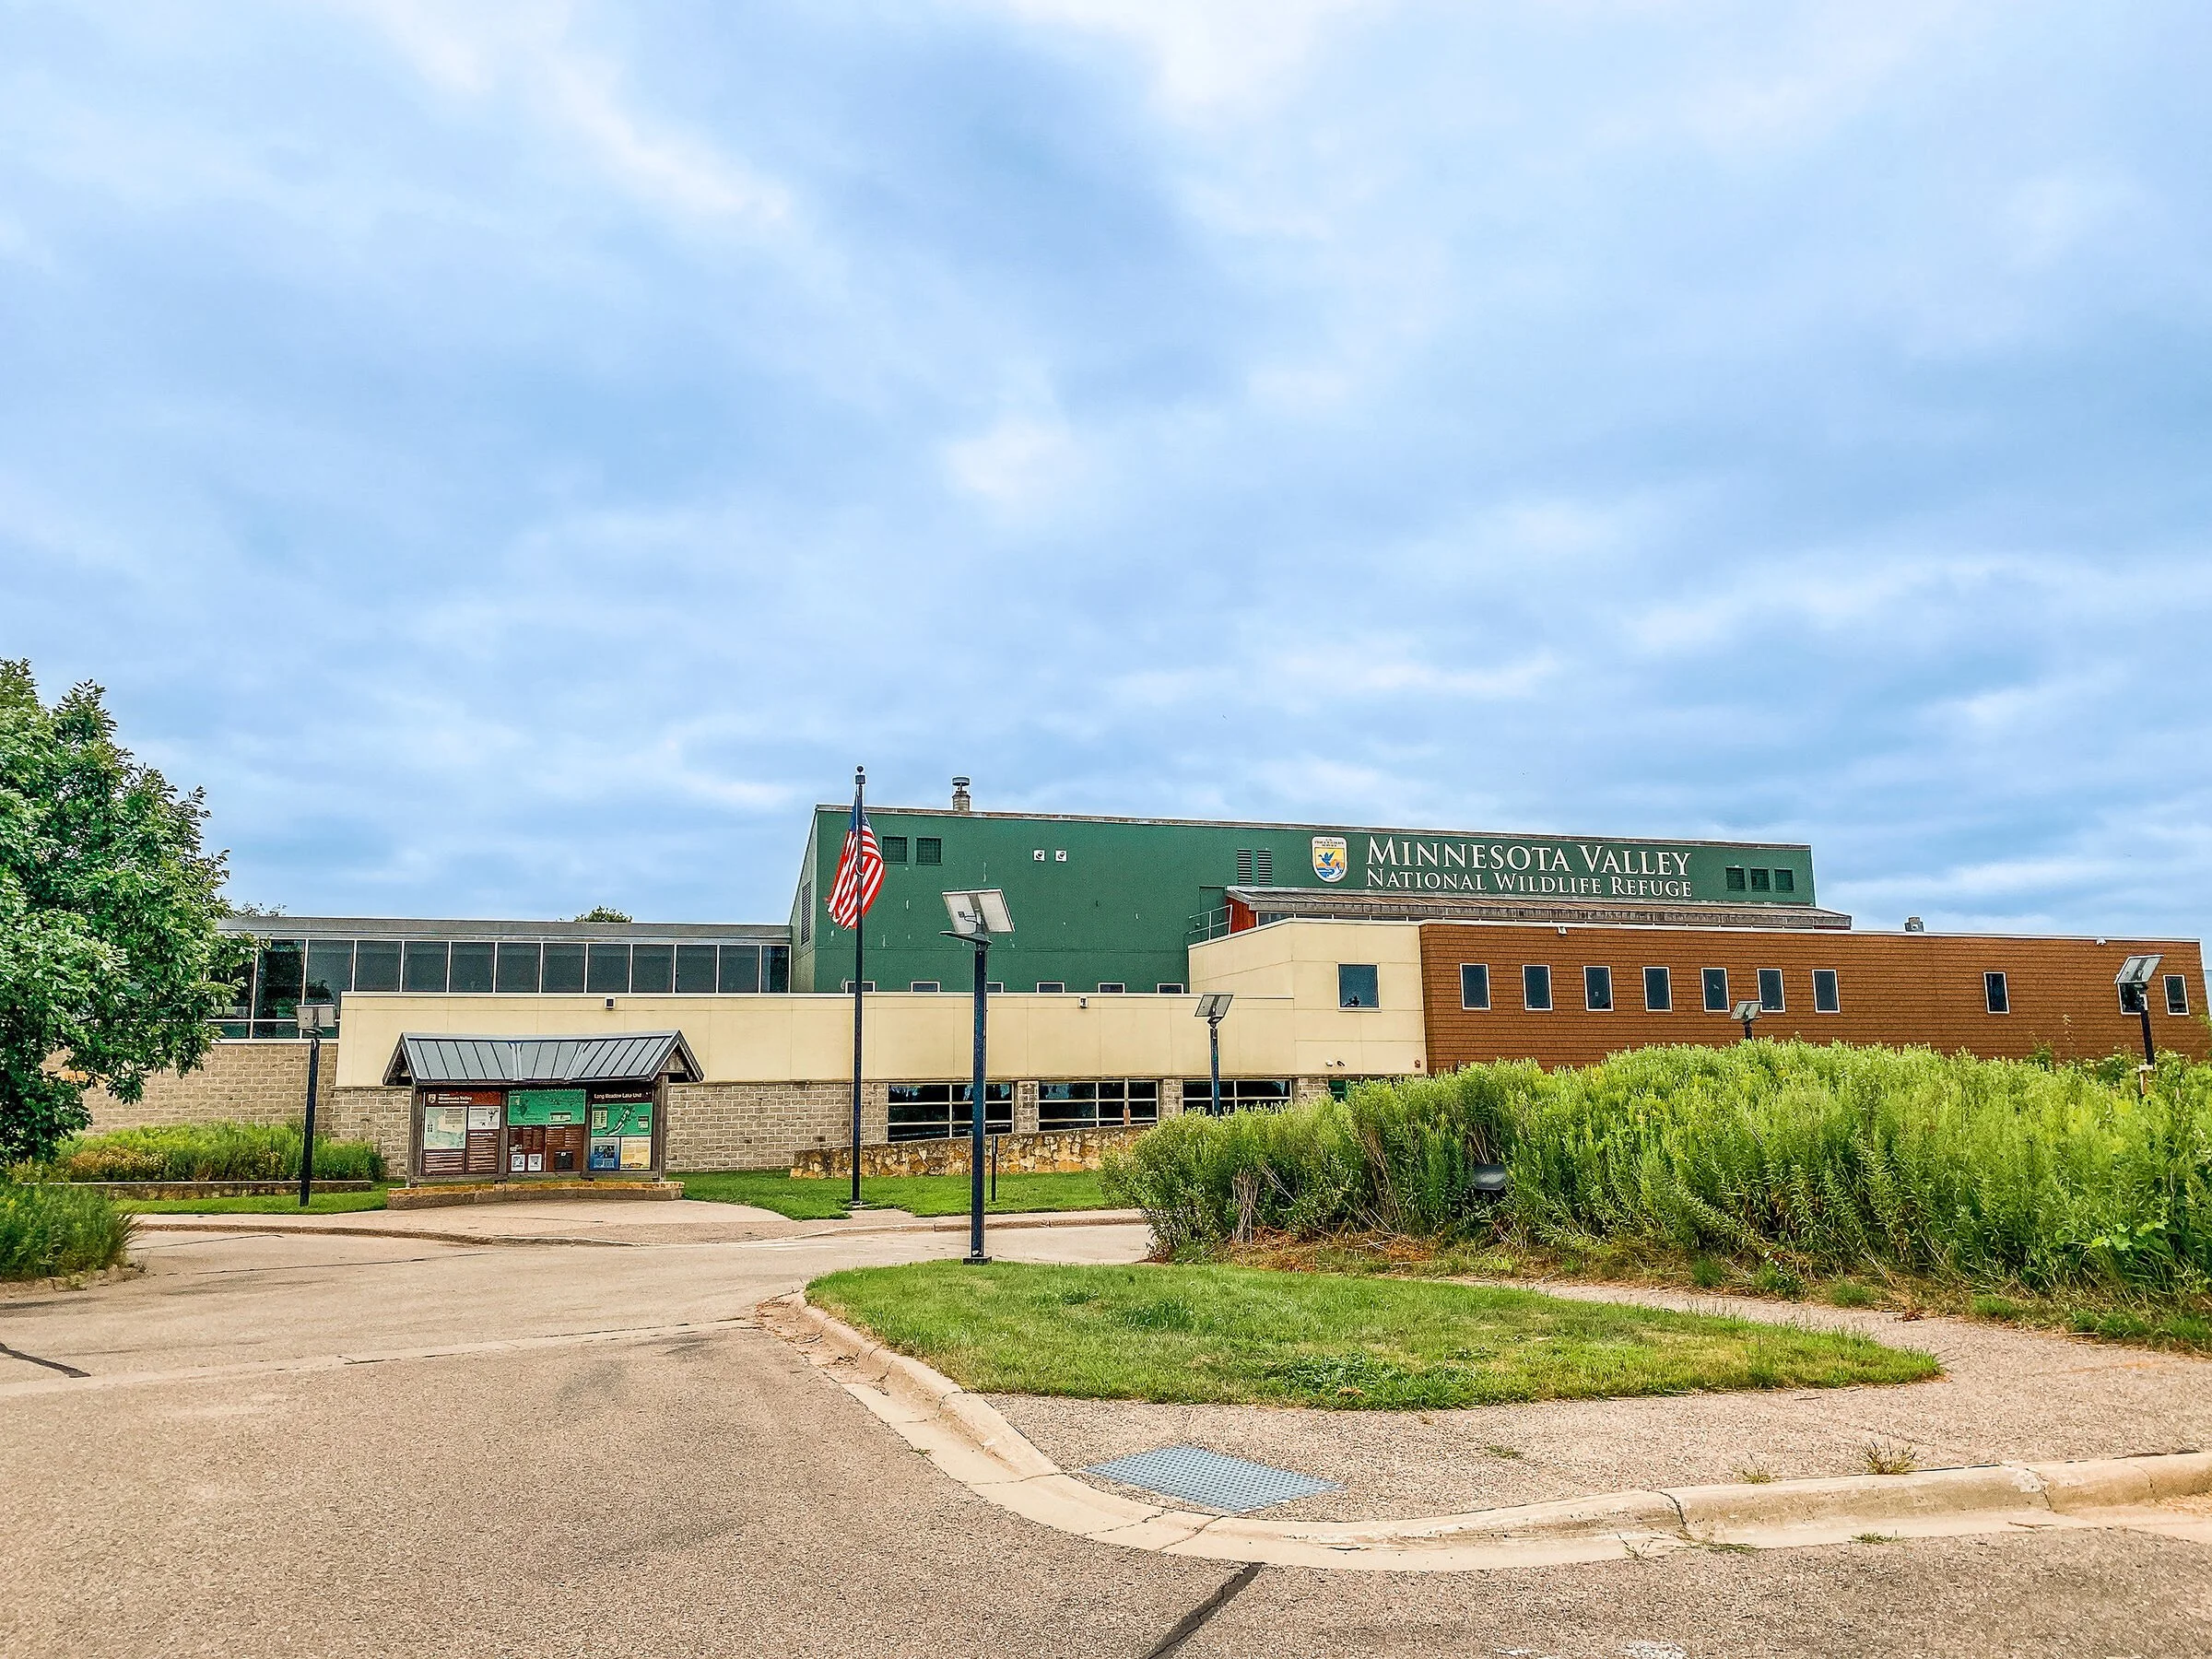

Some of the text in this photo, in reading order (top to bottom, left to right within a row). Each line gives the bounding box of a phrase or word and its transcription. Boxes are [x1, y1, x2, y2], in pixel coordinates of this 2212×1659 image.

[1365, 835, 1692, 877] MINNESOTA VALLEY
[1366, 867, 1692, 898] NATIONAL WILDLIFE REFUGE
